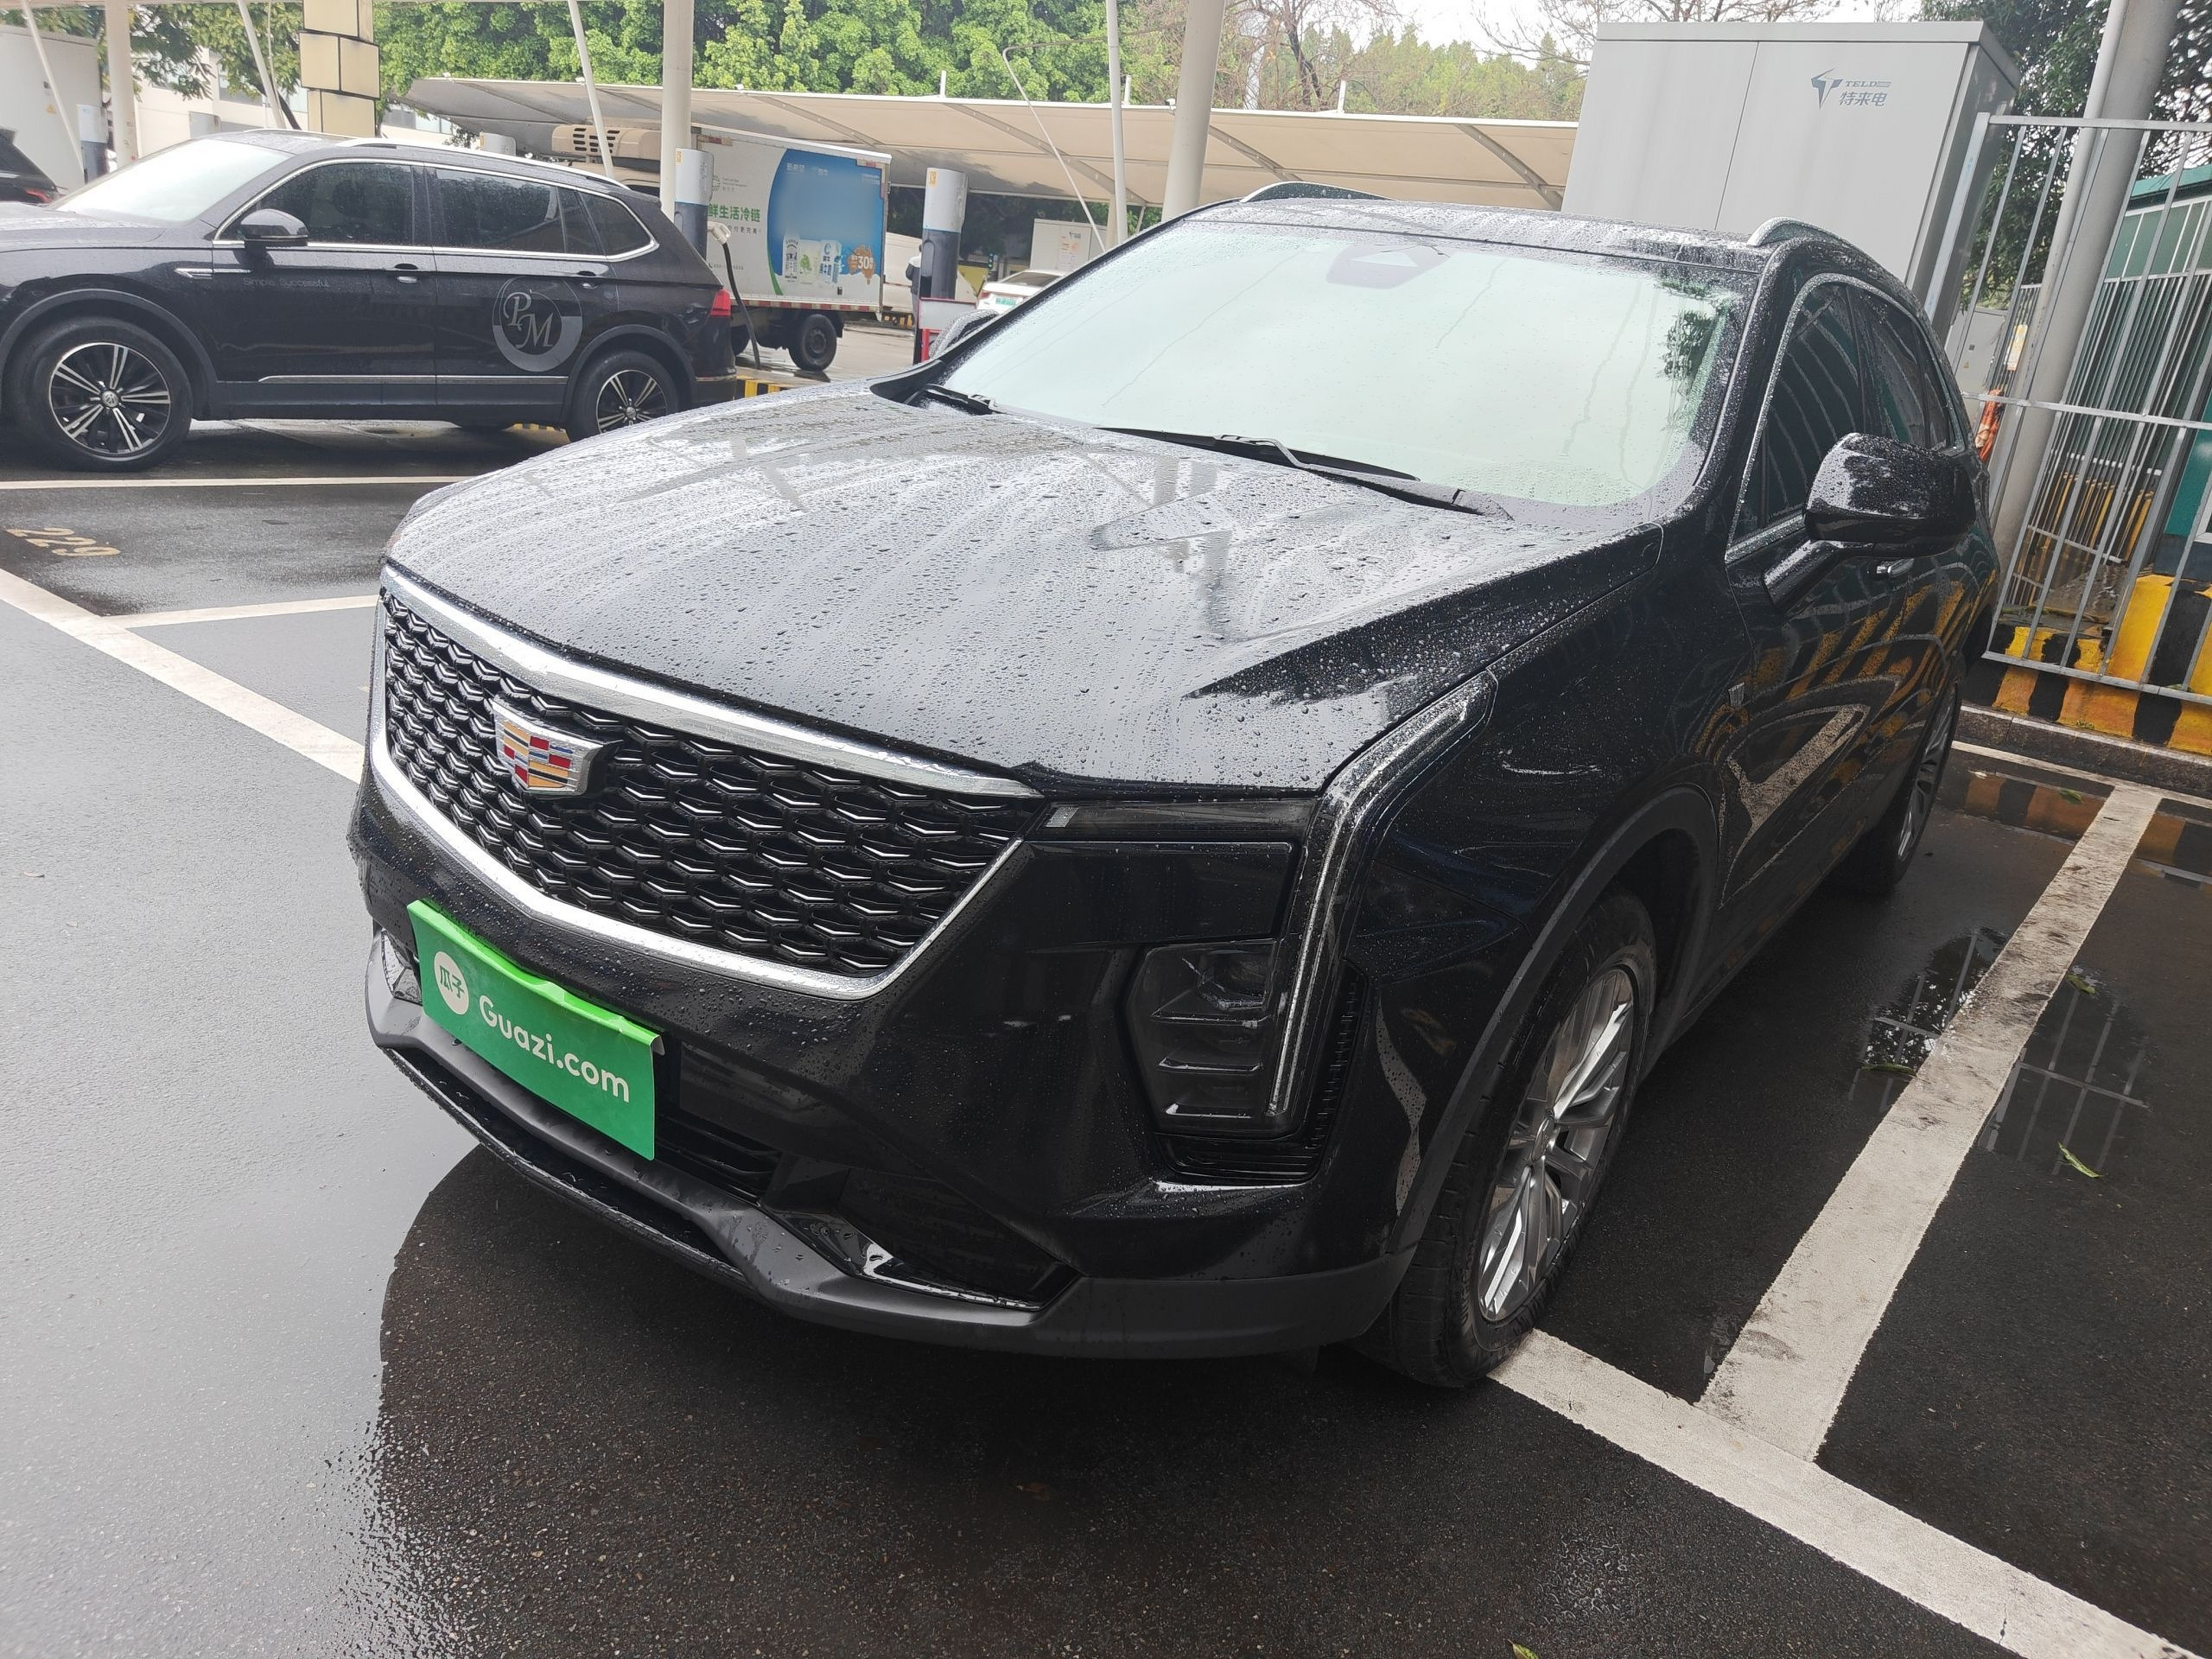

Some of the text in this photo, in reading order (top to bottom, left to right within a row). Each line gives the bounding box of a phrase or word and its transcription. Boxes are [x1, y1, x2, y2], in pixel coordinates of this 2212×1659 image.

[1839, 91, 1888, 107] 特来电
[708, 203, 761, 222] 鲜生活冷链
[440, 965, 465, 999] 瓜子
[479, 995, 630, 1103] Guazi.com
